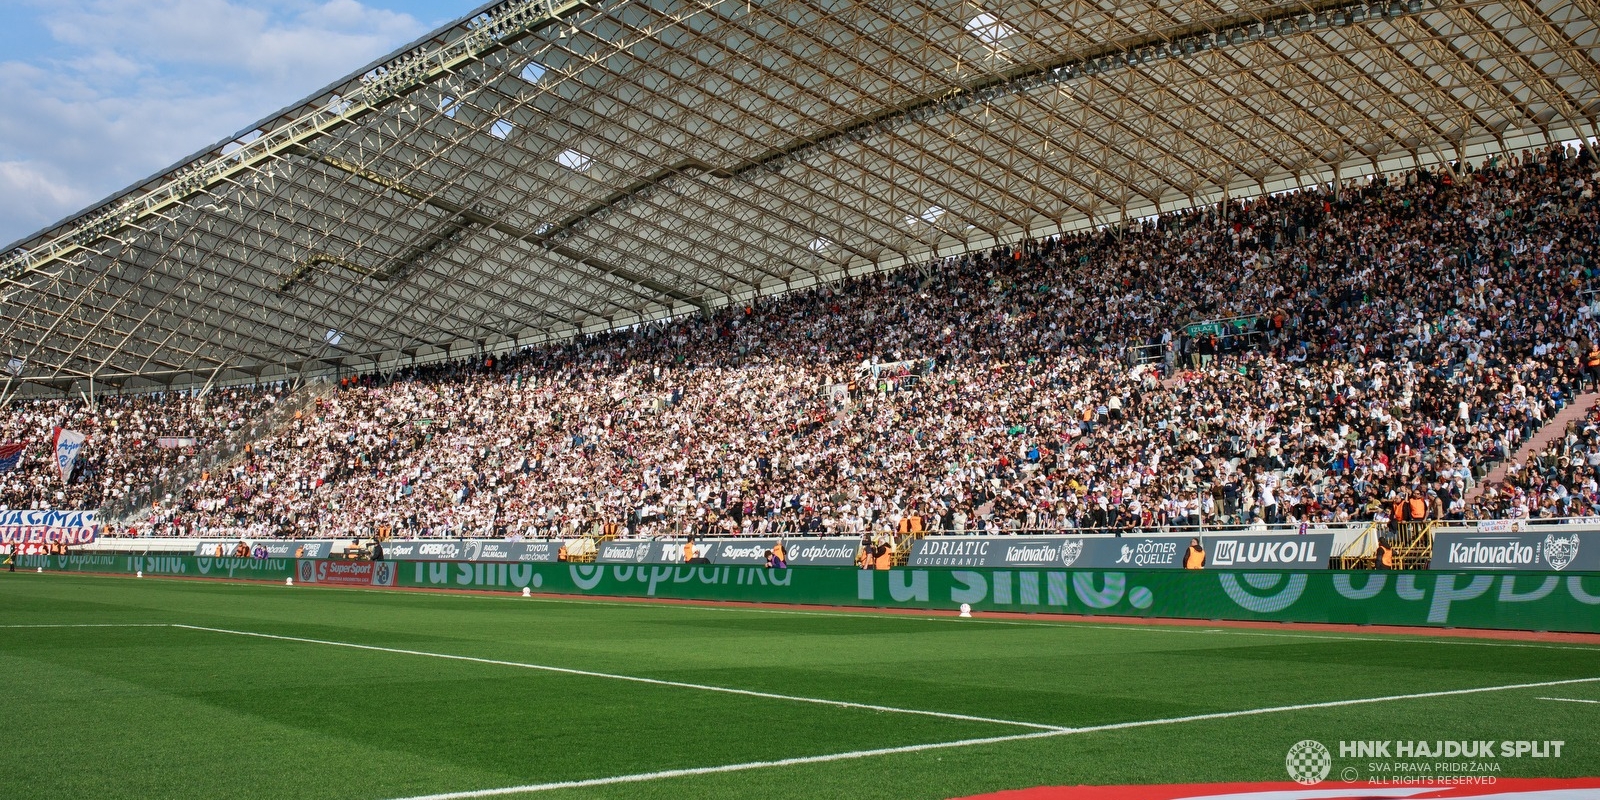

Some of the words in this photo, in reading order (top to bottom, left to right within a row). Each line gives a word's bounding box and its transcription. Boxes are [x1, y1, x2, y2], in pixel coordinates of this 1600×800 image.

[1190, 325, 1213, 333] IZLAZ
[419, 543, 456, 555] ORBICO
[525, 544, 549, 552] TOYOTA
[722, 545, 774, 560] SuperSp
[801, 544, 854, 561] otpbanka
[919, 541, 990, 556] ADRIATIC
[1005, 545, 1056, 562] Karlovačko
[1235, 541, 1318, 563] LUKOIL
[1448, 541, 1532, 563] Karlovačko
[916, 557, 986, 566] OSIGURANJE
[1134, 553, 1175, 566] QUELLE
[329, 562, 372, 575] SuperSport
